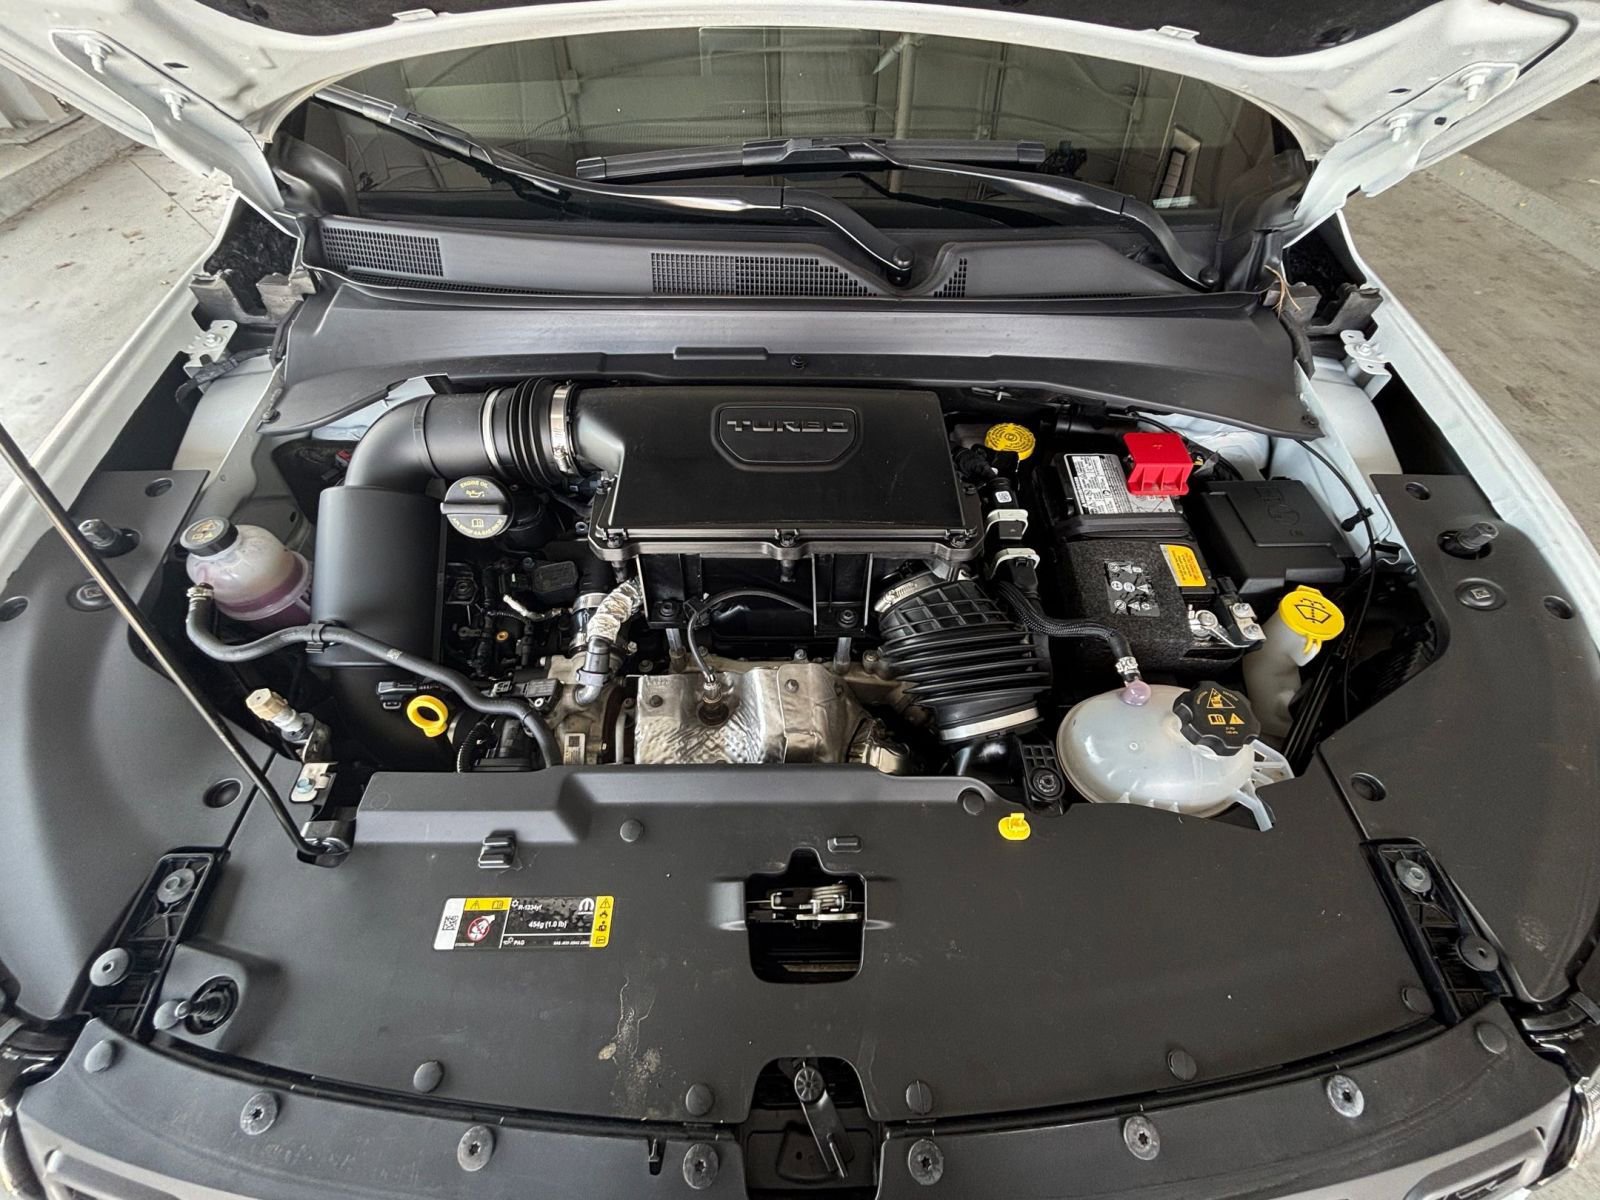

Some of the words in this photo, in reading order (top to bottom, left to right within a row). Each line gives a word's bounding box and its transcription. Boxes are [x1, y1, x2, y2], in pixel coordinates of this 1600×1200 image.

[726, 420, 849, 433] TURBO
[460, 480, 479, 488] ENGINE
[528, 921, 545, 929] 454g
